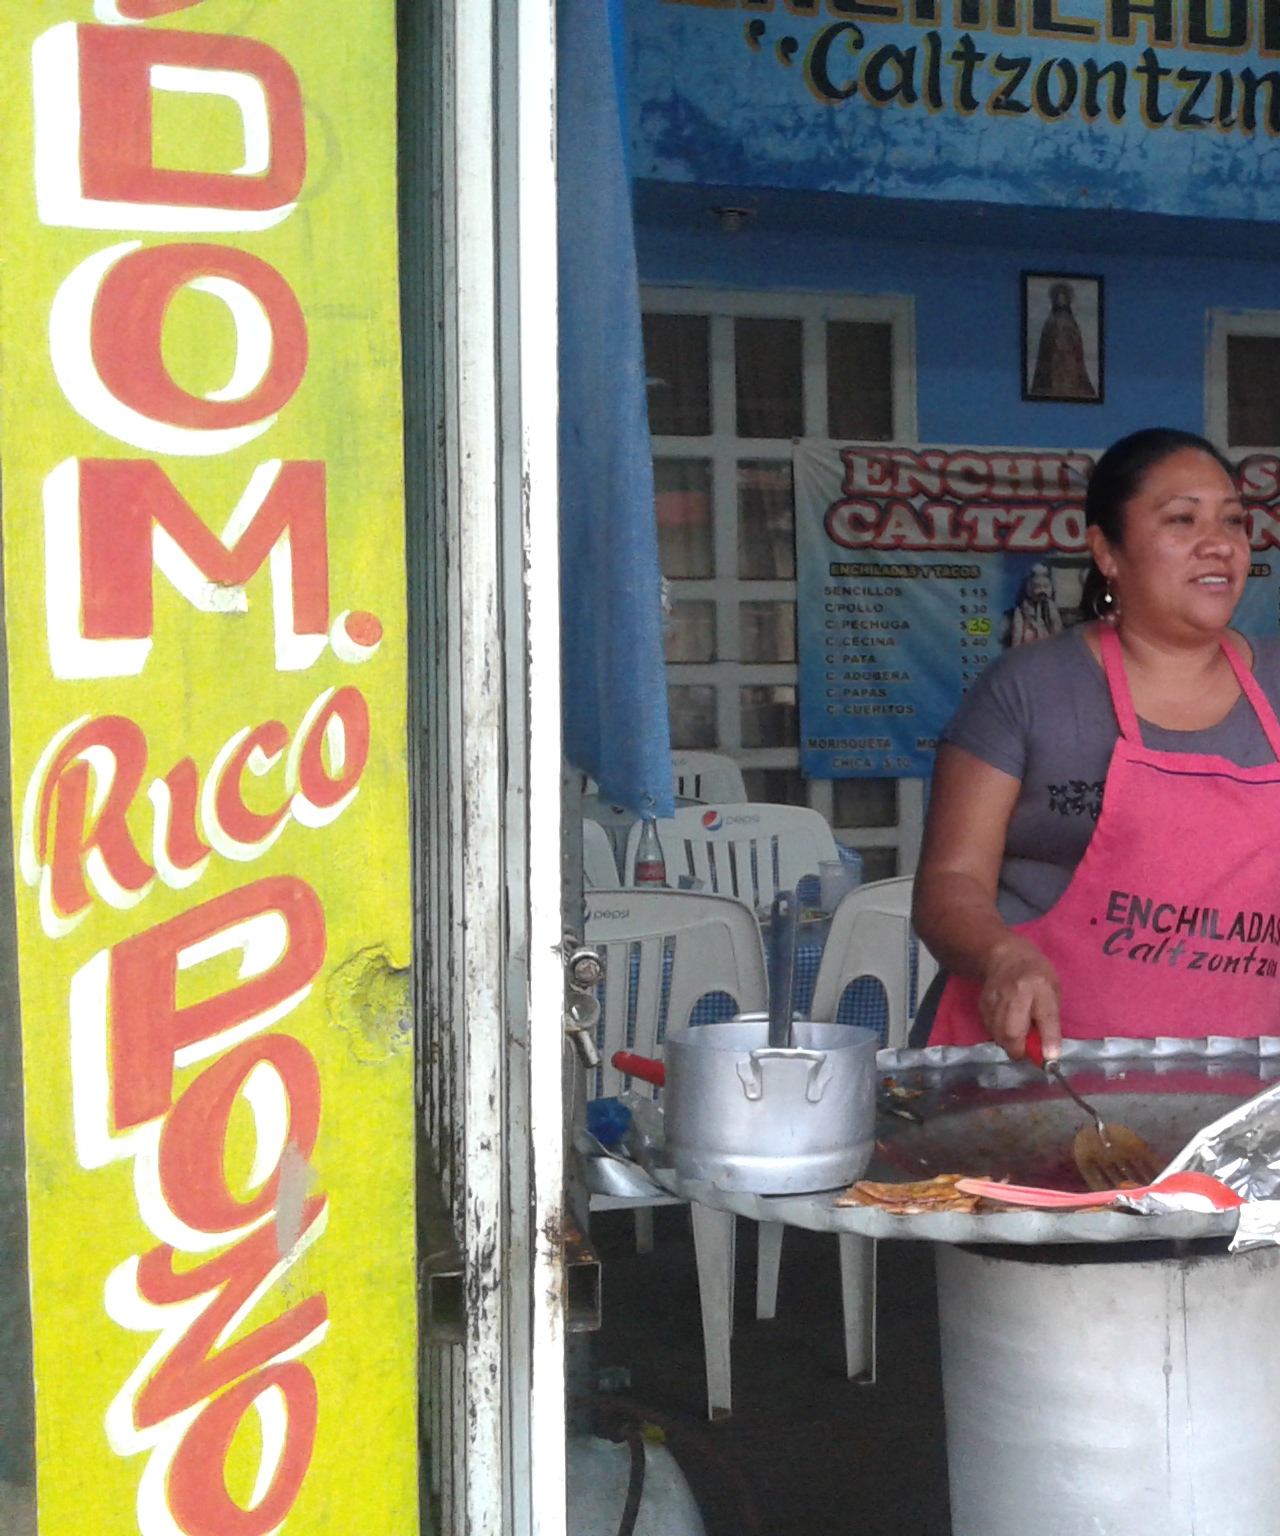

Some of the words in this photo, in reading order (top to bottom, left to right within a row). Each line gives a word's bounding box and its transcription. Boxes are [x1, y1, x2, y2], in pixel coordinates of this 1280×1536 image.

[824, 586, 903, 597] SENCILLOS
[842, 619, 910, 631] PECHUGA
[842, 638, 895, 648] CECINA
[843, 655, 877, 665] PATA
[843, 671, 910, 682] ADOBERA
[843, 688, 887, 699] PAPAS
[843, 705, 914, 715] CUERITOS
[808, 739, 892, 750] MORISQUETA
[593, 907, 631, 926] pepsi
